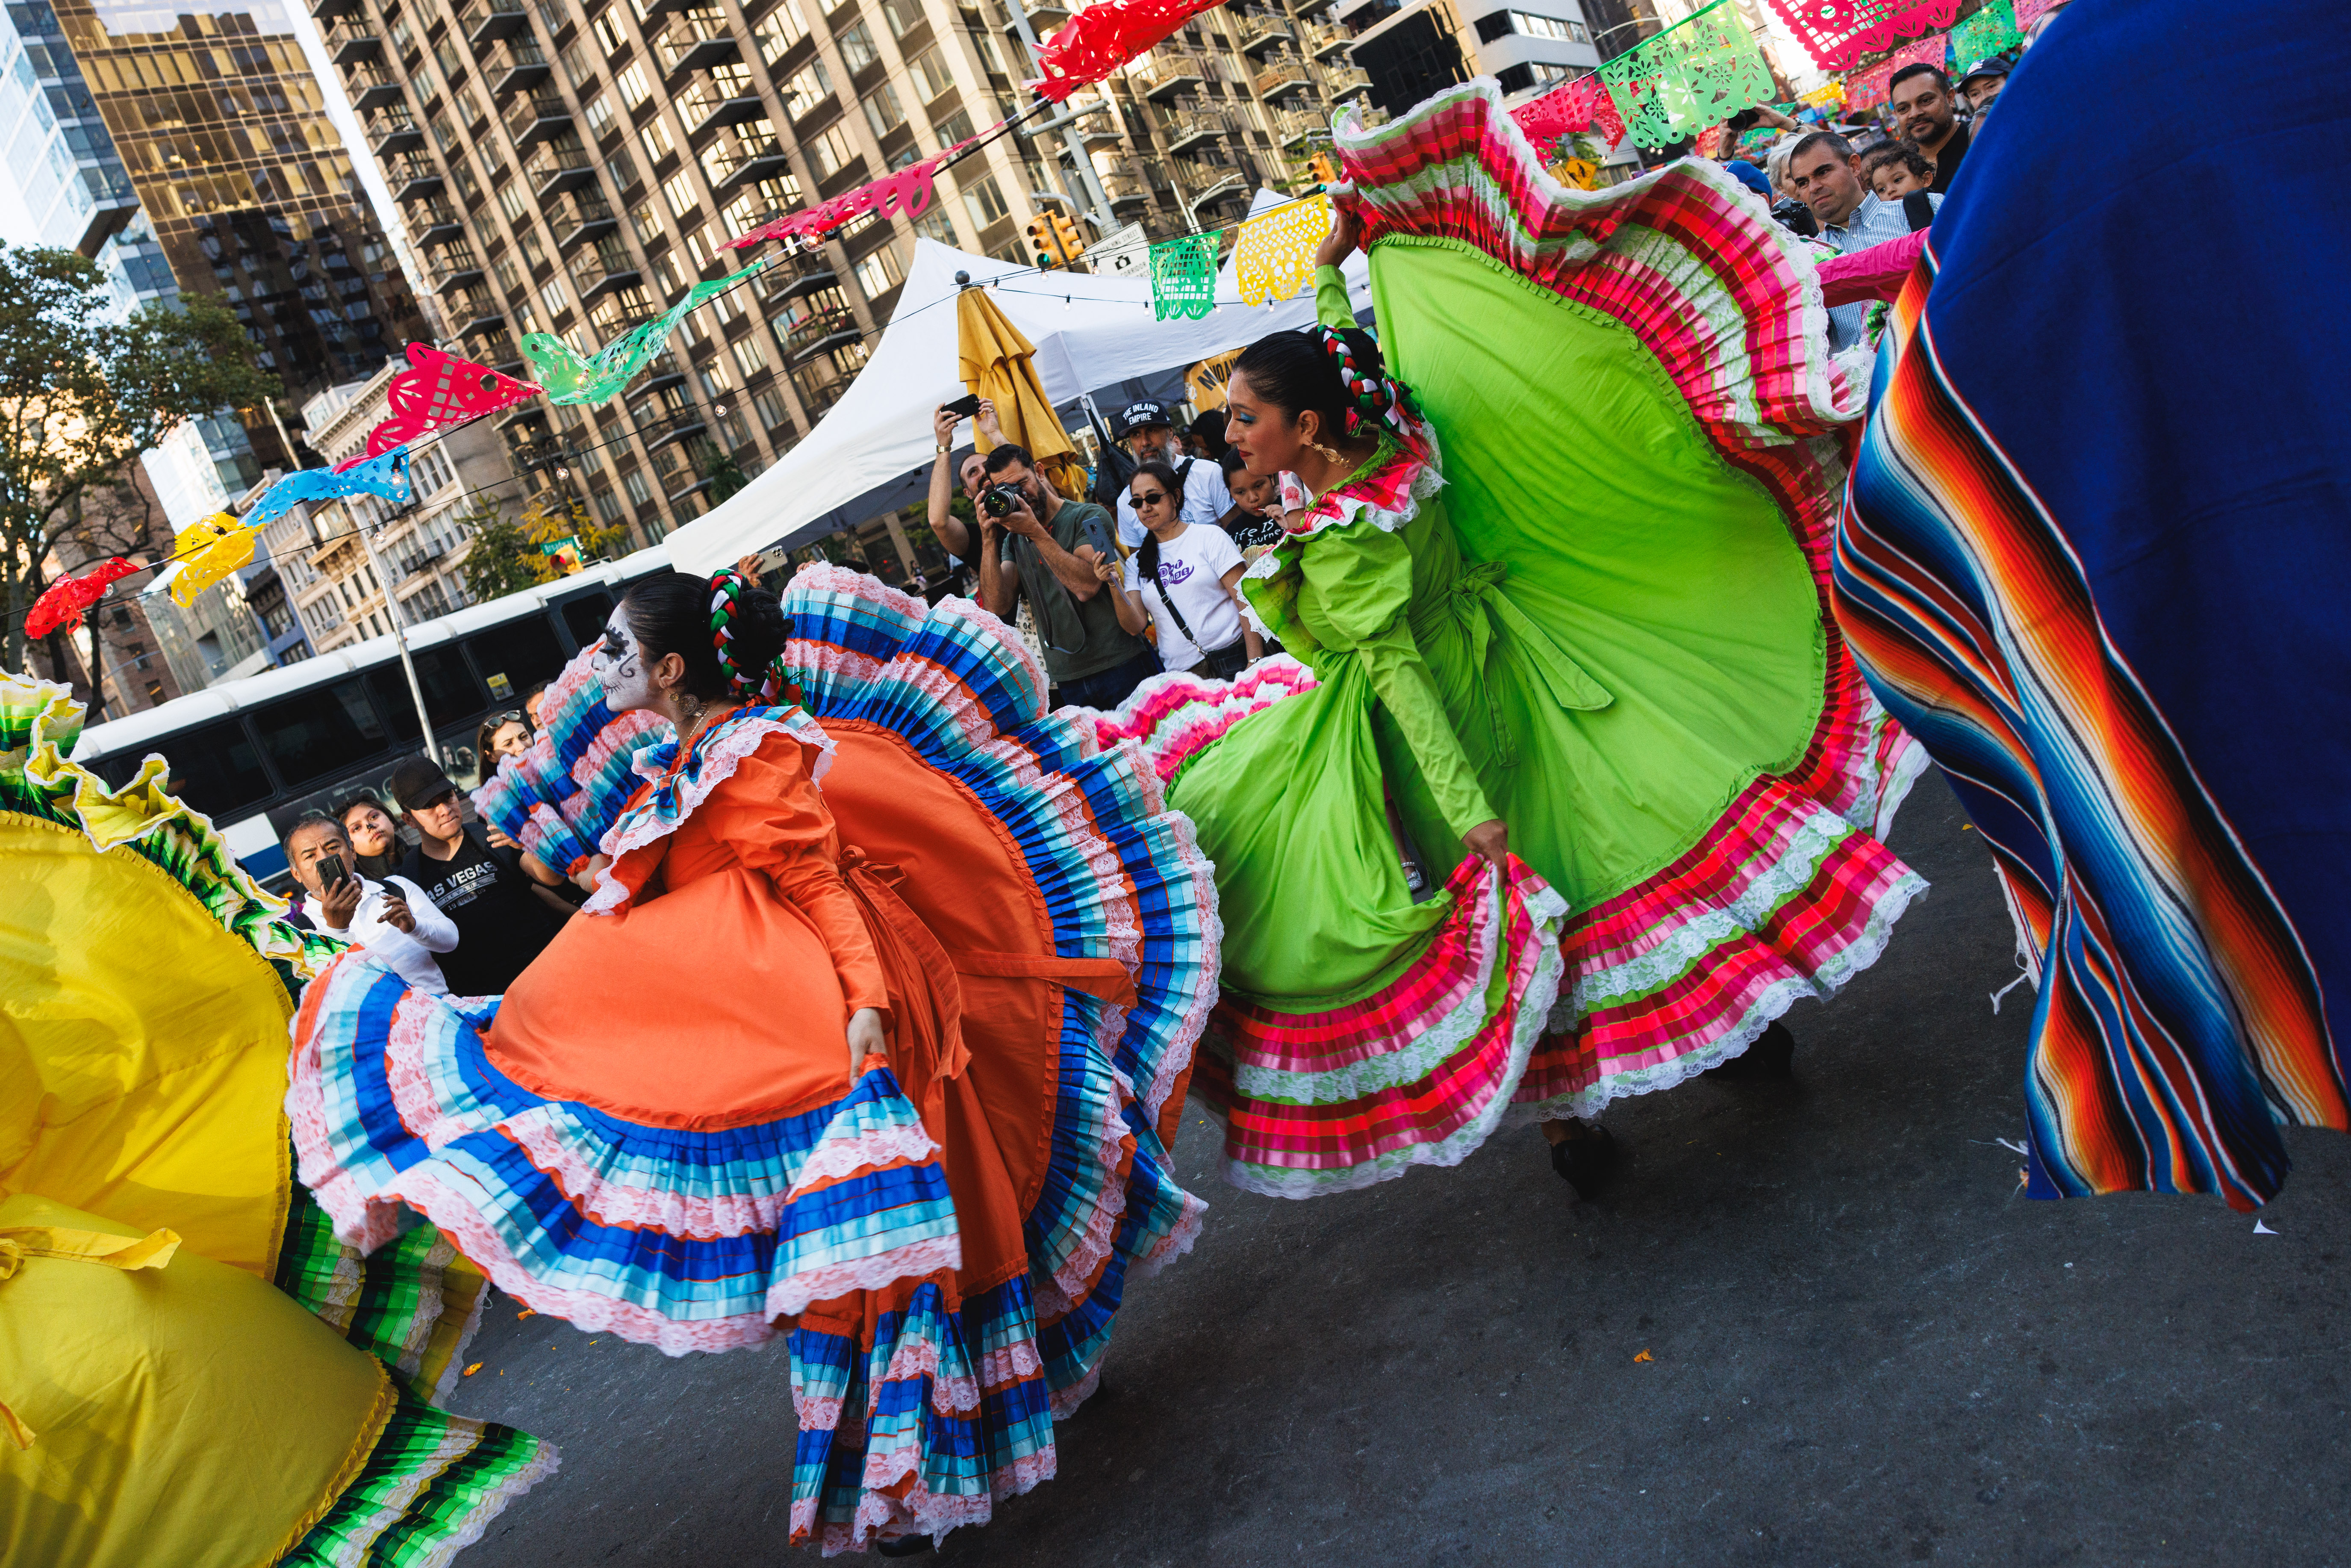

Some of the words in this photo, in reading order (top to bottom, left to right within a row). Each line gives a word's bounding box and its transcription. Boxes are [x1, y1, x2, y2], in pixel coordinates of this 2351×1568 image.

[1094, 238, 1121, 256] PPROACHING
[1122, 229, 1138, 242] STREET
[1122, 407, 1132, 421] THE
[1132, 403, 1159, 413] INLAND
[1128, 412, 1152, 425] EMPIRE
[1230, 528, 1258, 542] ife
[426, 882, 445, 902] AS
[445, 861, 498, 888] VEGAS
[448, 902, 457, 911] 19
